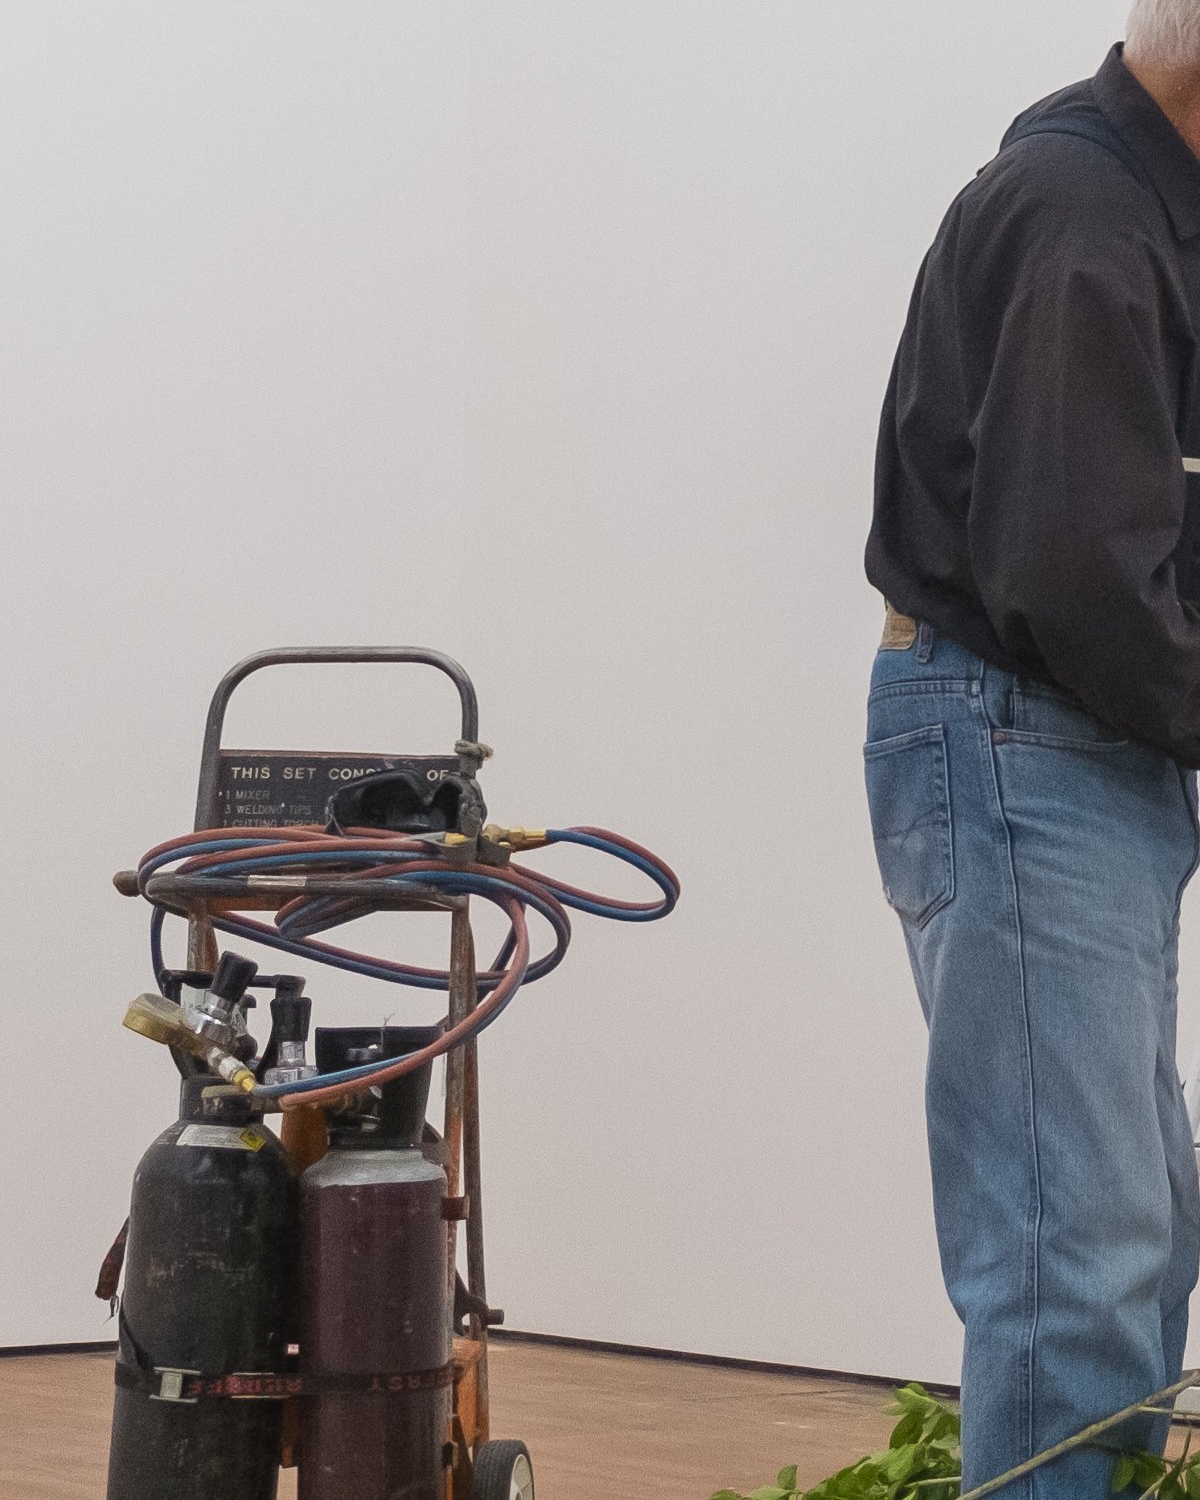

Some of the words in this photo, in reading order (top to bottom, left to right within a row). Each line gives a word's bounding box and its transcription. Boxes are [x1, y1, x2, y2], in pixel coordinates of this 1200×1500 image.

[231, 766, 271, 780] THIS
[283, 767, 317, 781] SET
[235, 789, 270, 800] MIXER
[225, 804, 231, 814] 3
[236, 804, 283, 815] WELDING
[289, 804, 312, 815] TIPS
